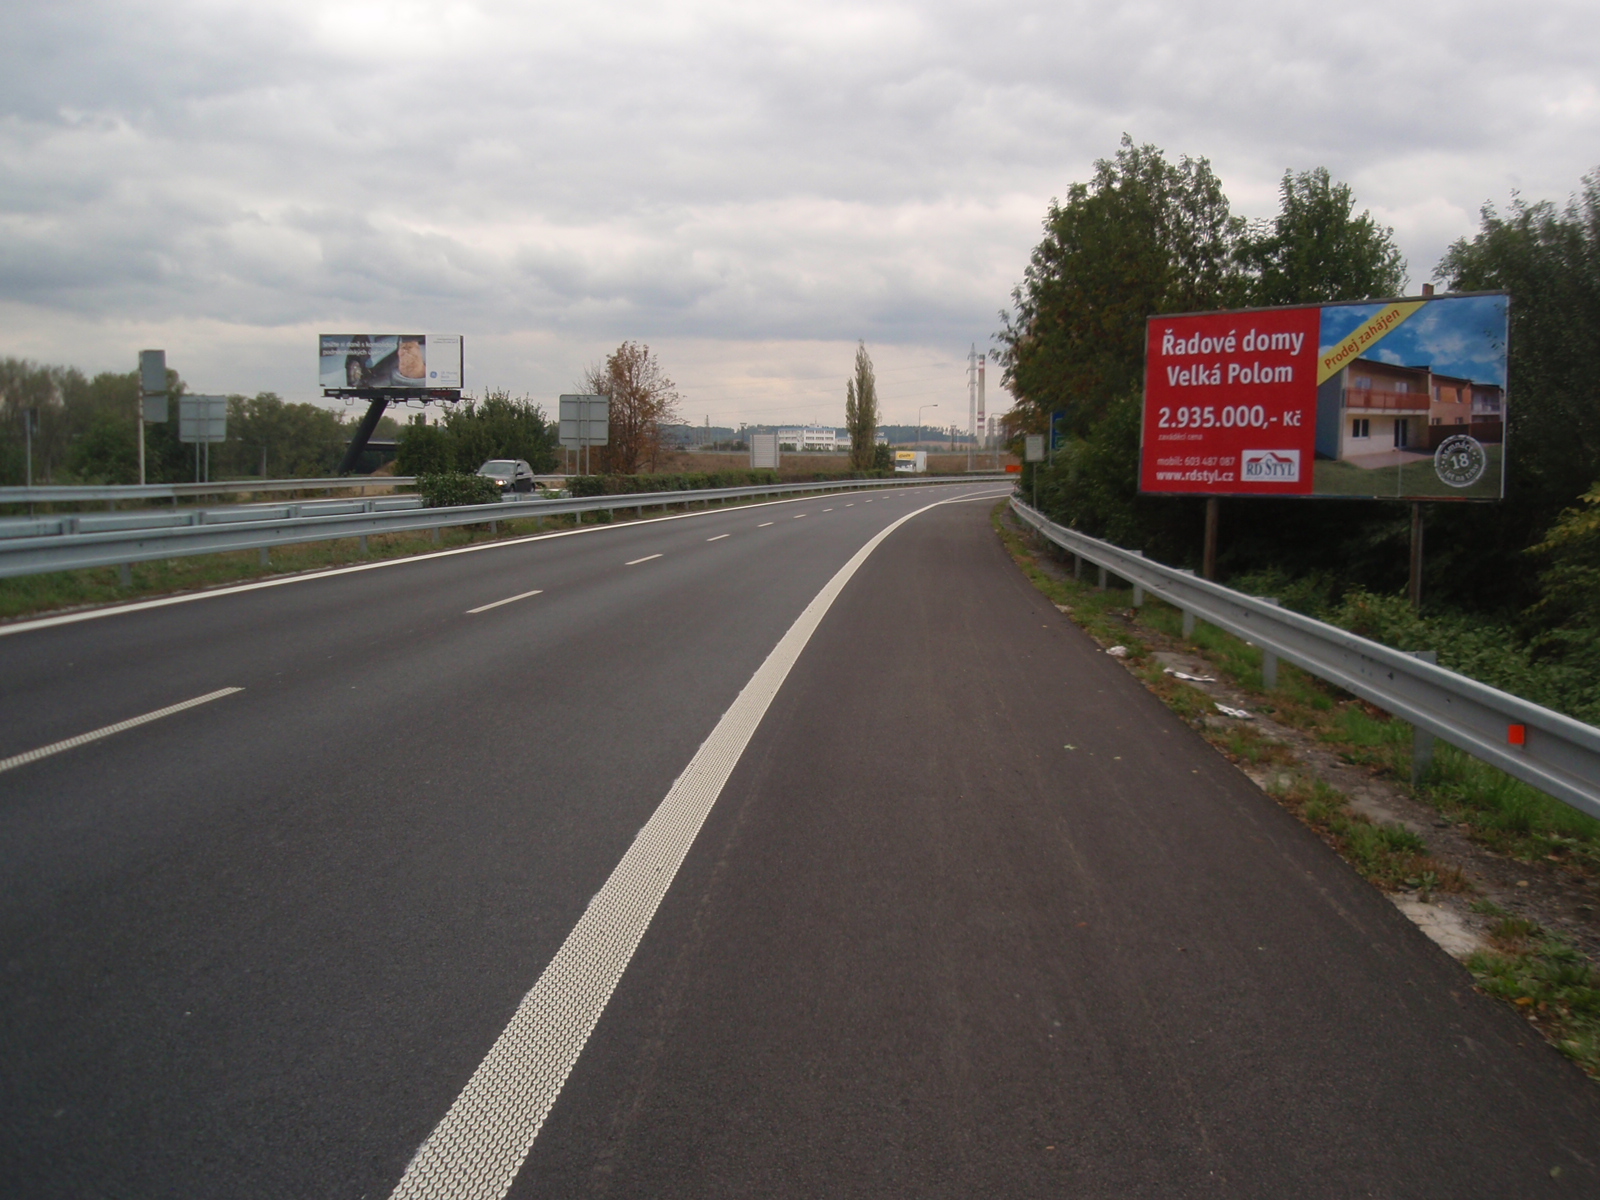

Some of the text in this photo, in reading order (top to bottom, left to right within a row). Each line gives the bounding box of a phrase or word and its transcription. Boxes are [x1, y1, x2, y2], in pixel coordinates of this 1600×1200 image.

[1161, 328, 1305, 356] Řadové domy
[1324, 309, 1400, 370] Prodej zahájen
[1166, 361, 1294, 387] Velká Polom
[1158, 404, 1302, 430] 2.935.000,- Kč
[1184, 456, 1201, 466] 603
[1246, 462, 1263, 476] RD
[1450, 452, 1470, 470] 18
[1155, 469, 1235, 484] www.rdstyl.cz
